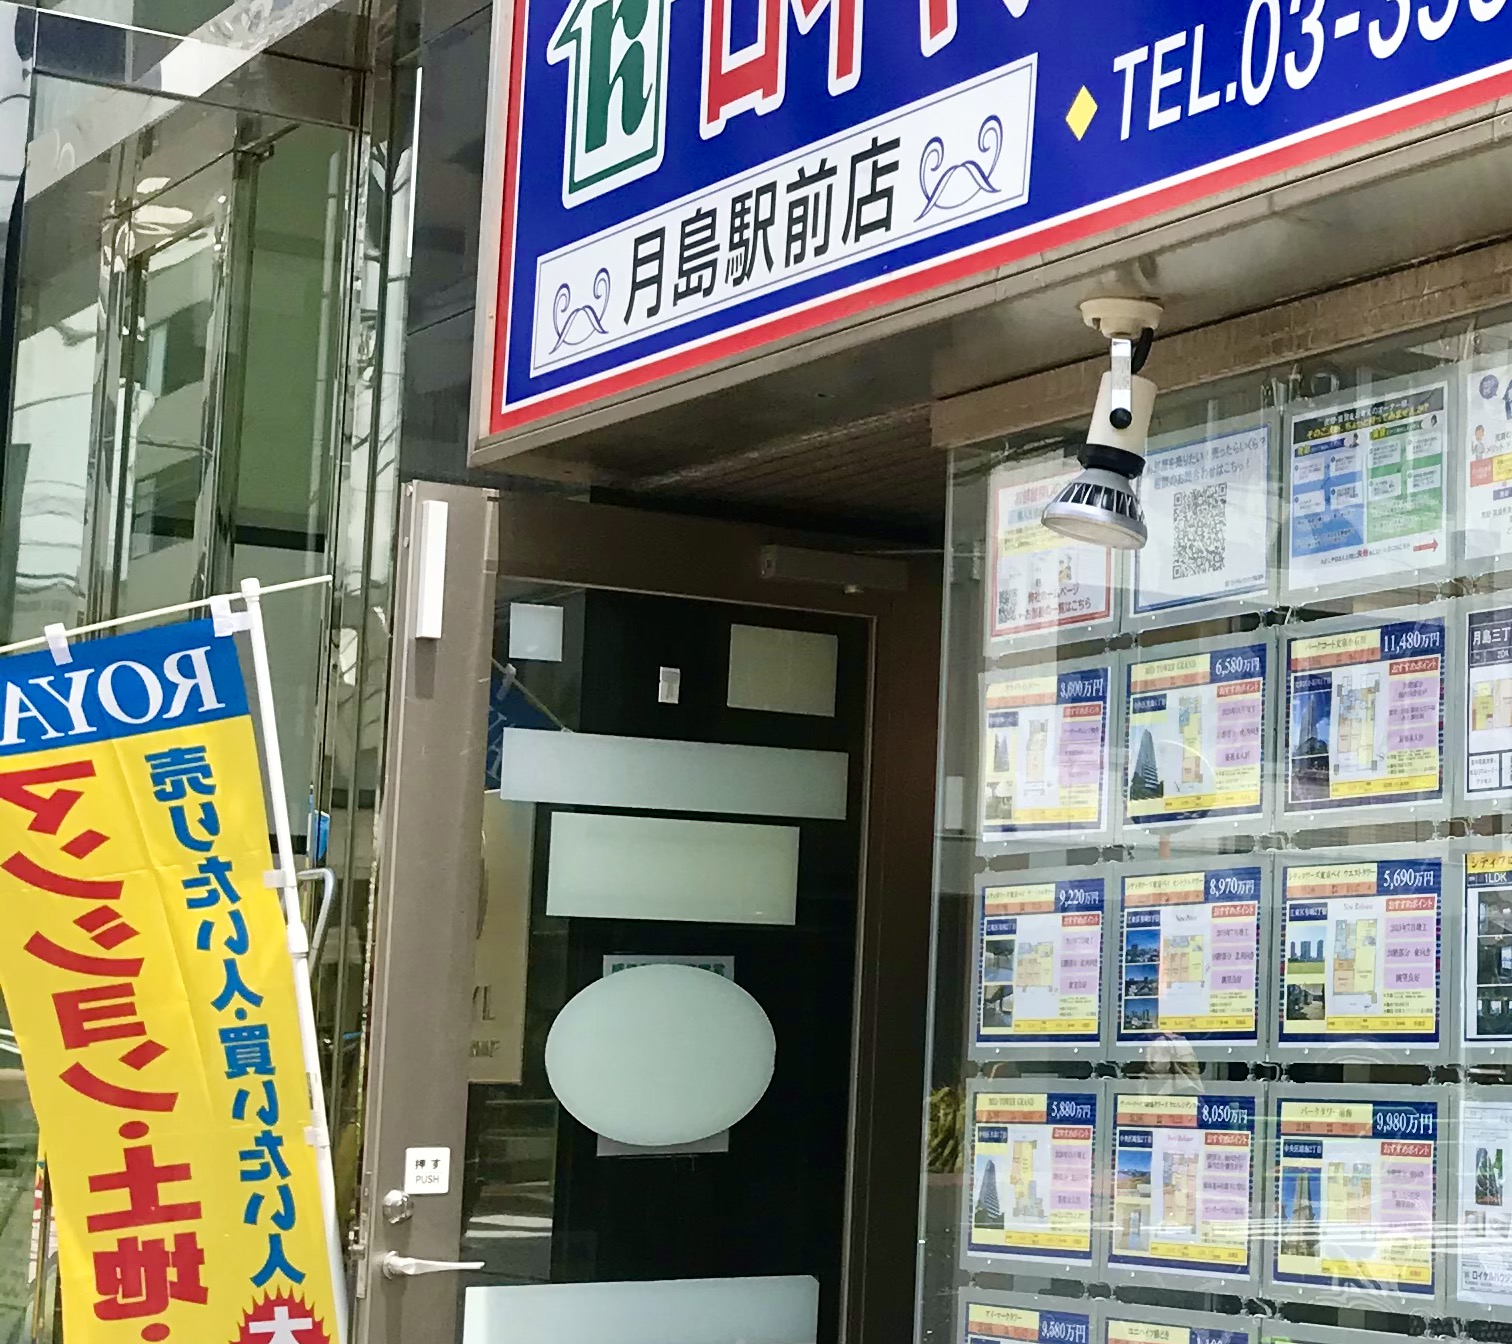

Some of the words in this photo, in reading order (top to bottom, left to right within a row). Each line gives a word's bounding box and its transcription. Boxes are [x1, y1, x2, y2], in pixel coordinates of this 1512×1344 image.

[622, 136, 902, 326] 月島駅前店
[1384, 630, 1441, 654] 11,480万円
[1215, 655, 1260, 676] 6,580万円
[1210, 877, 1254, 897] 8,970万円
[1383, 868, 1434, 890] 5,690万円
[1485, 872, 1508, 883] 1LDK
[1059, 889, 1099, 907] 9,220万円
[1202, 1104, 1248, 1125] 8,050万円
[1376, 1113, 1433, 1135] 9,980万円
[1383, 1144, 1430, 1156] おすすめポイント
[415, 1158, 441, 1170] 押す
[415, 1174, 440, 1184] PUSH
[1041, 1319, 1087, 1344] 9,580万円
